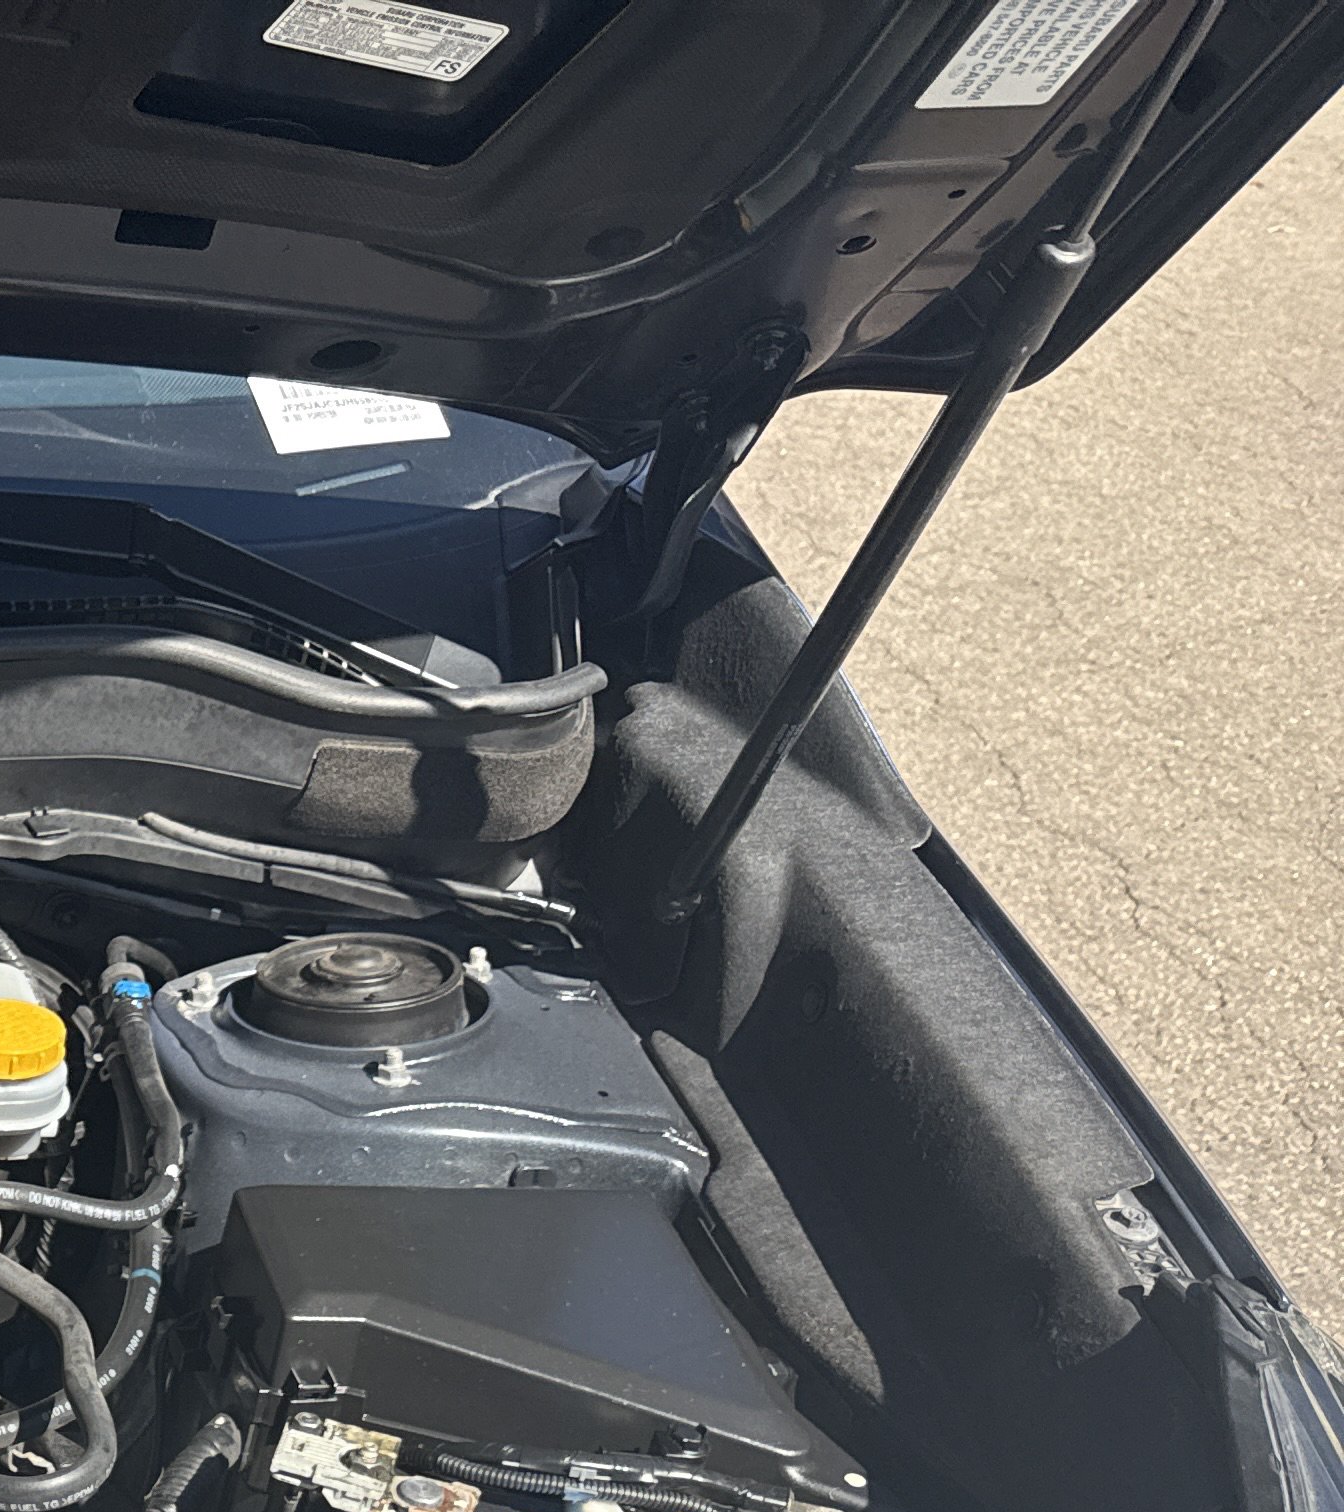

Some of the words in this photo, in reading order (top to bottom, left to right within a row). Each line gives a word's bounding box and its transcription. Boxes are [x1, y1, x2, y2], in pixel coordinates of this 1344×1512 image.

[1039, 0, 1060, 17] VE
[1079, 0, 1102, 20] HIS
[981, 0, 1039, 60] MPORTED
[998, 19, 1046, 65] PRICES
[1023, 0, 1083, 59] VAILABLE
[1031, 23, 1084, 74] VEHICLE
[432, 59, 462, 75] FS
[952, 62, 989, 96] CARS
[967, 66, 1005, 101] FROM
[1010, 61, 1030, 76] AT
[1037, 54, 1078, 93] PARTS
[125, 1210, 148, 1222] FUEL
[10, 1503, 40, 1512] FUEL
